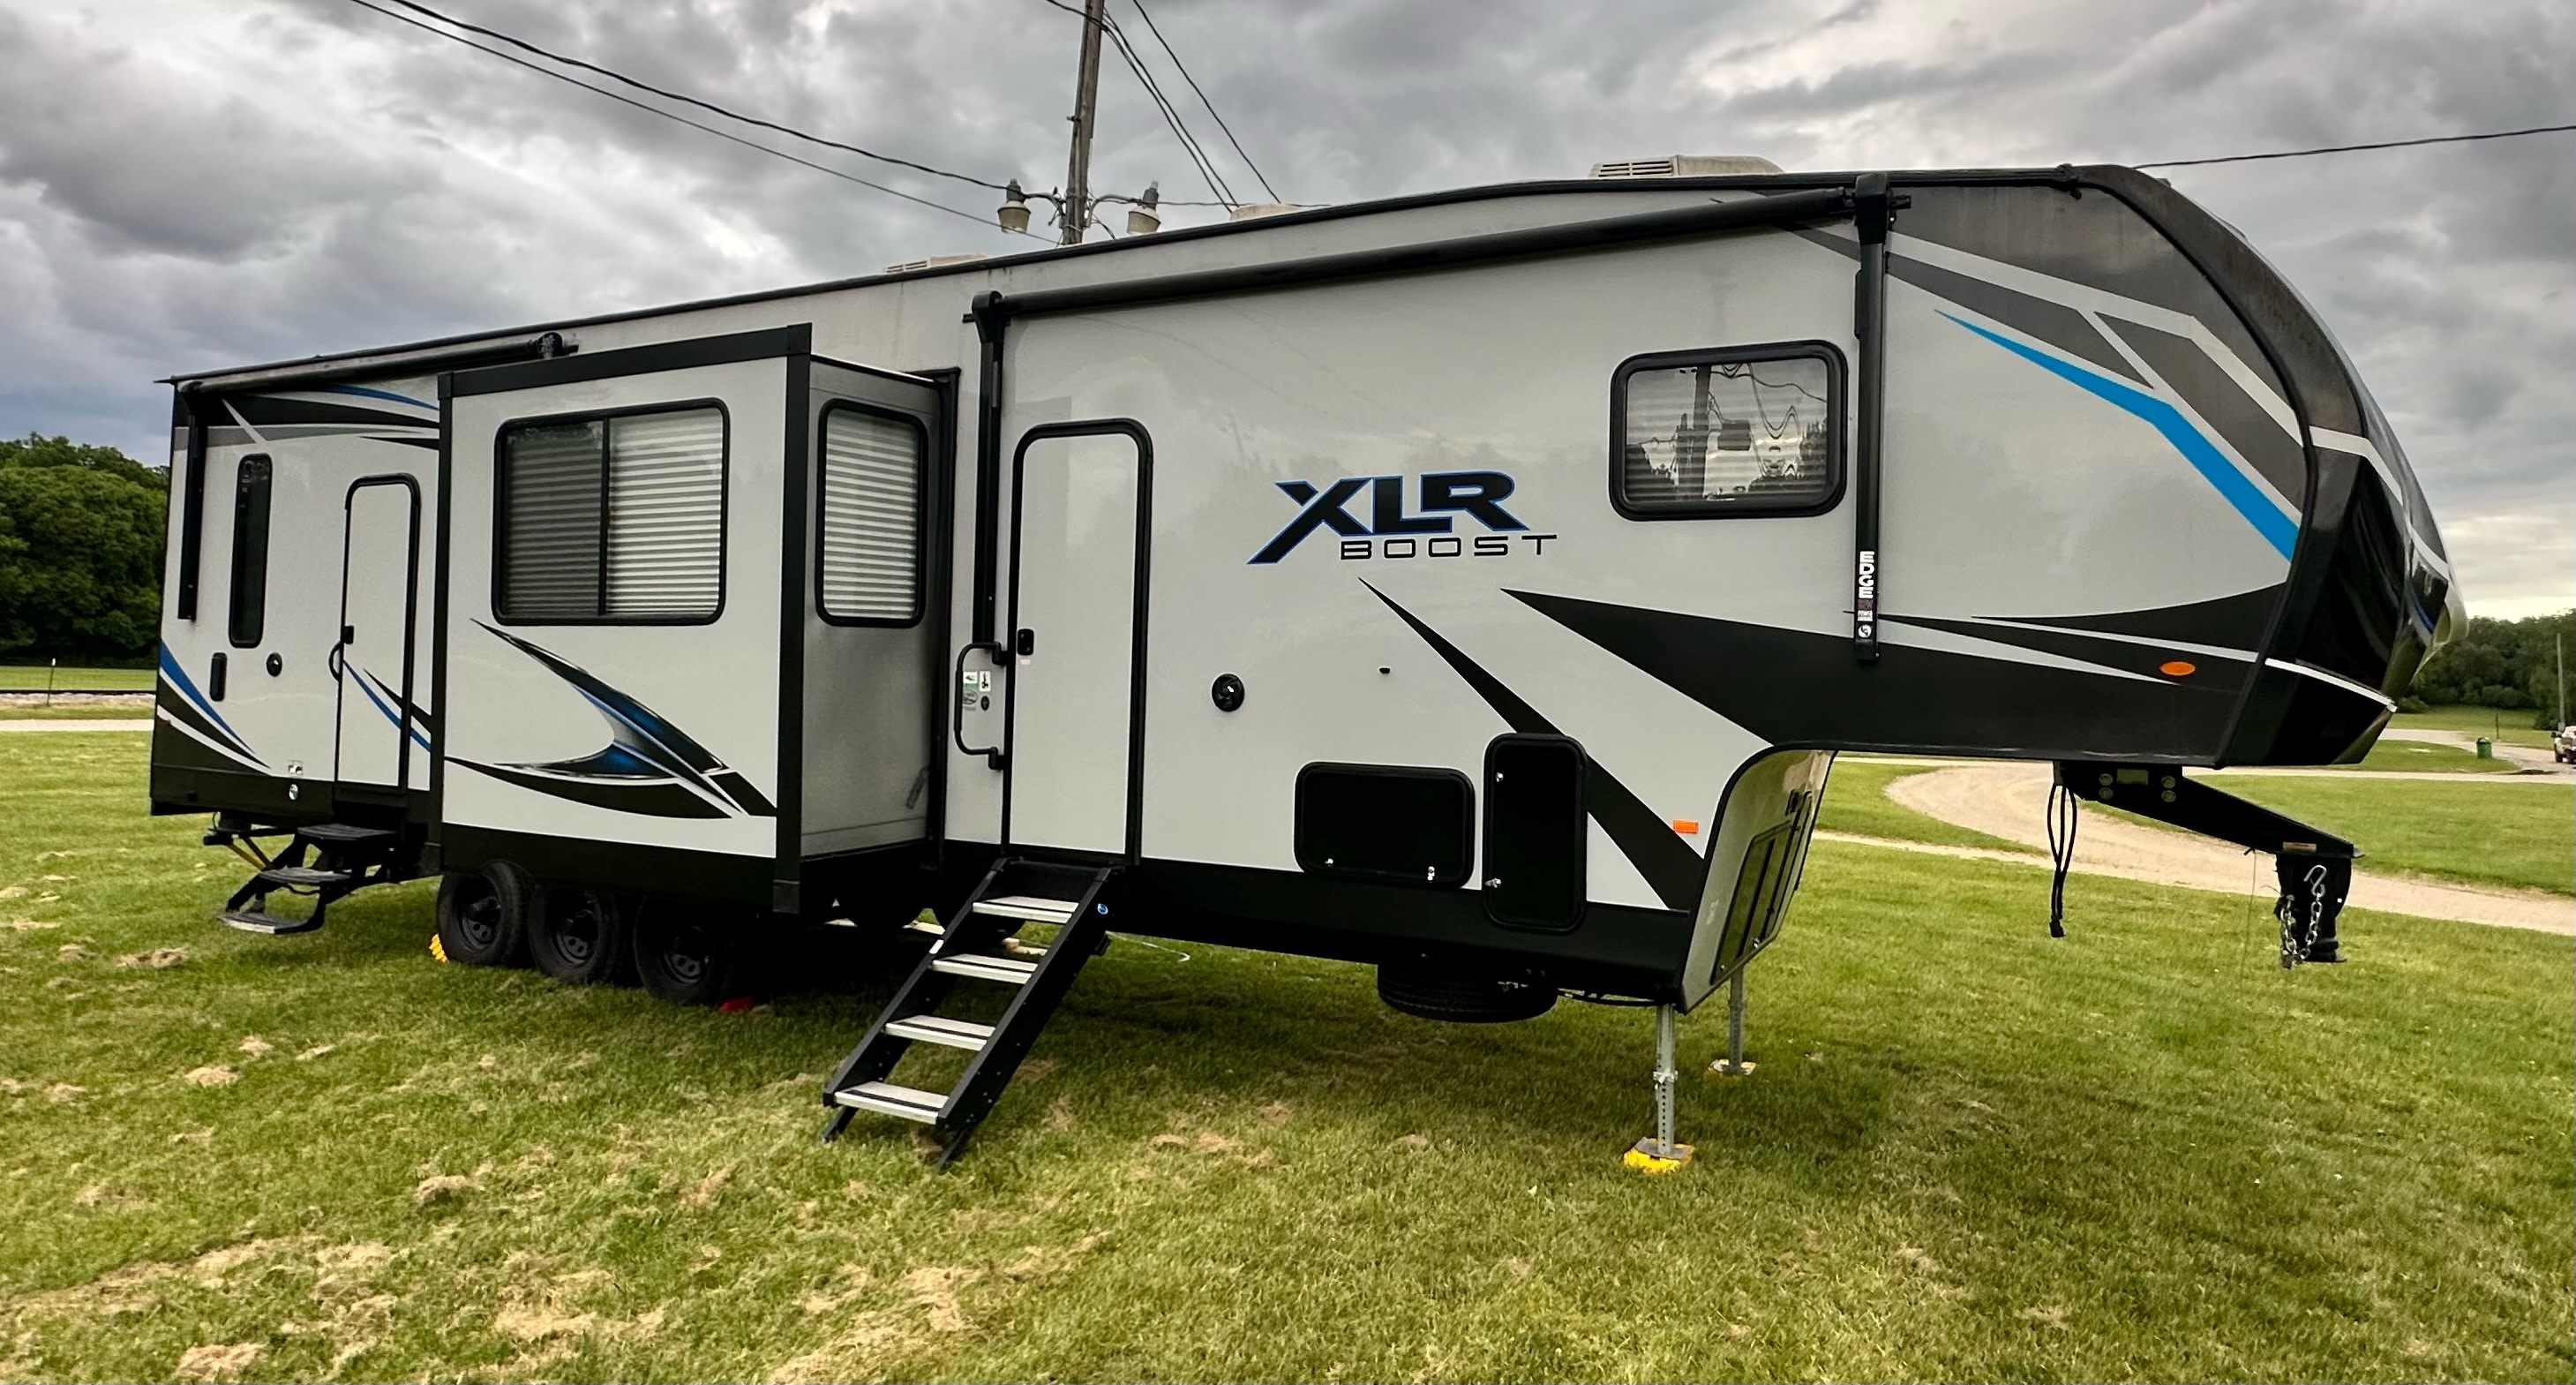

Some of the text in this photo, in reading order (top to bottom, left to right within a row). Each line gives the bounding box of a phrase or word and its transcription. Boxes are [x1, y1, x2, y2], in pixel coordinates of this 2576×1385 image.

[1246, 471, 1530, 565] XLR
[1340, 534, 1558, 561] BOOST
[1858, 550, 1875, 599] EDGE
